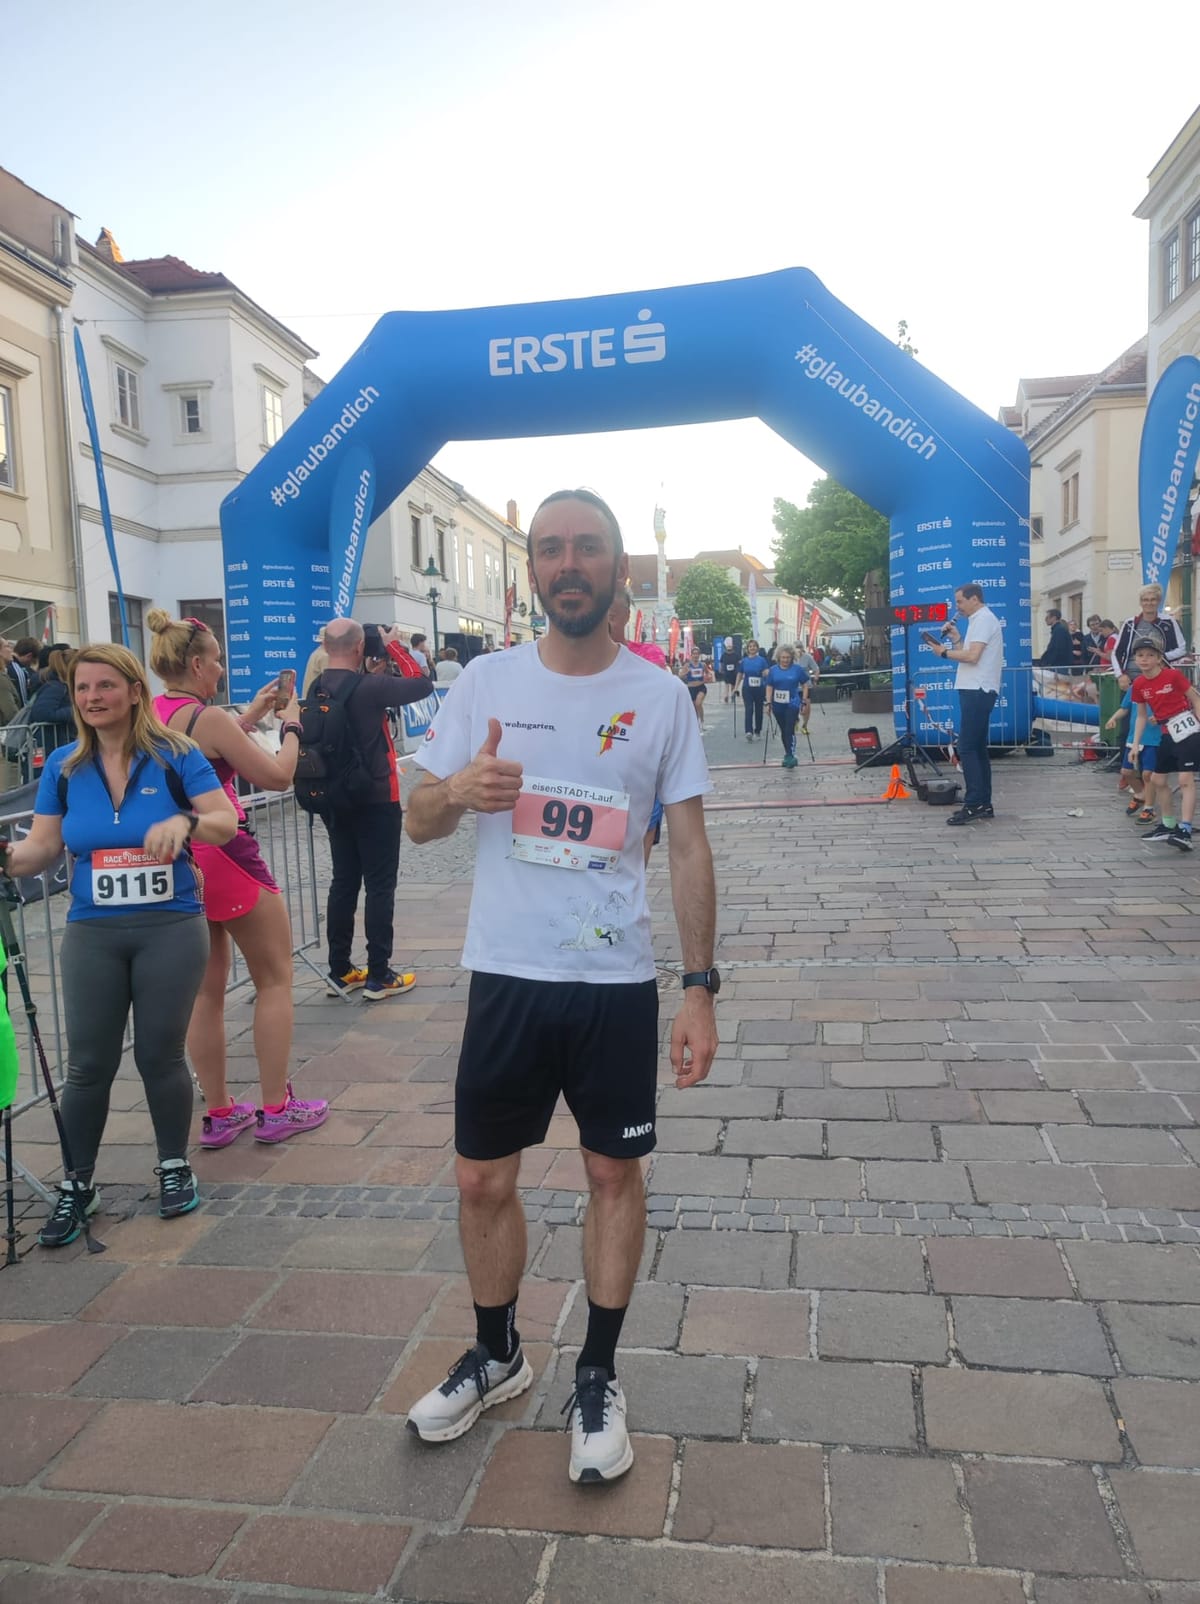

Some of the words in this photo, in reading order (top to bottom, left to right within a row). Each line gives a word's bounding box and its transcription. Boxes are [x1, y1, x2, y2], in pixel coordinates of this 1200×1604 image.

[489, 328, 616, 377] ERSTE
[794, 343, 937, 460] #glaubandich
[270, 385, 381, 507] #glaubandich
[1146, 381, 1200, 584] #glaubandich
[333, 468, 371, 618] #glaubandich
[1173, 717, 1195, 734] 218
[532, 782, 614, 804] eisenSTADT-Lauf
[541, 800, 594, 842] 99
[103, 855, 123, 863] RACE
[97, 871, 168, 899] 9115
[622, 1122, 653, 1139] JAKO
